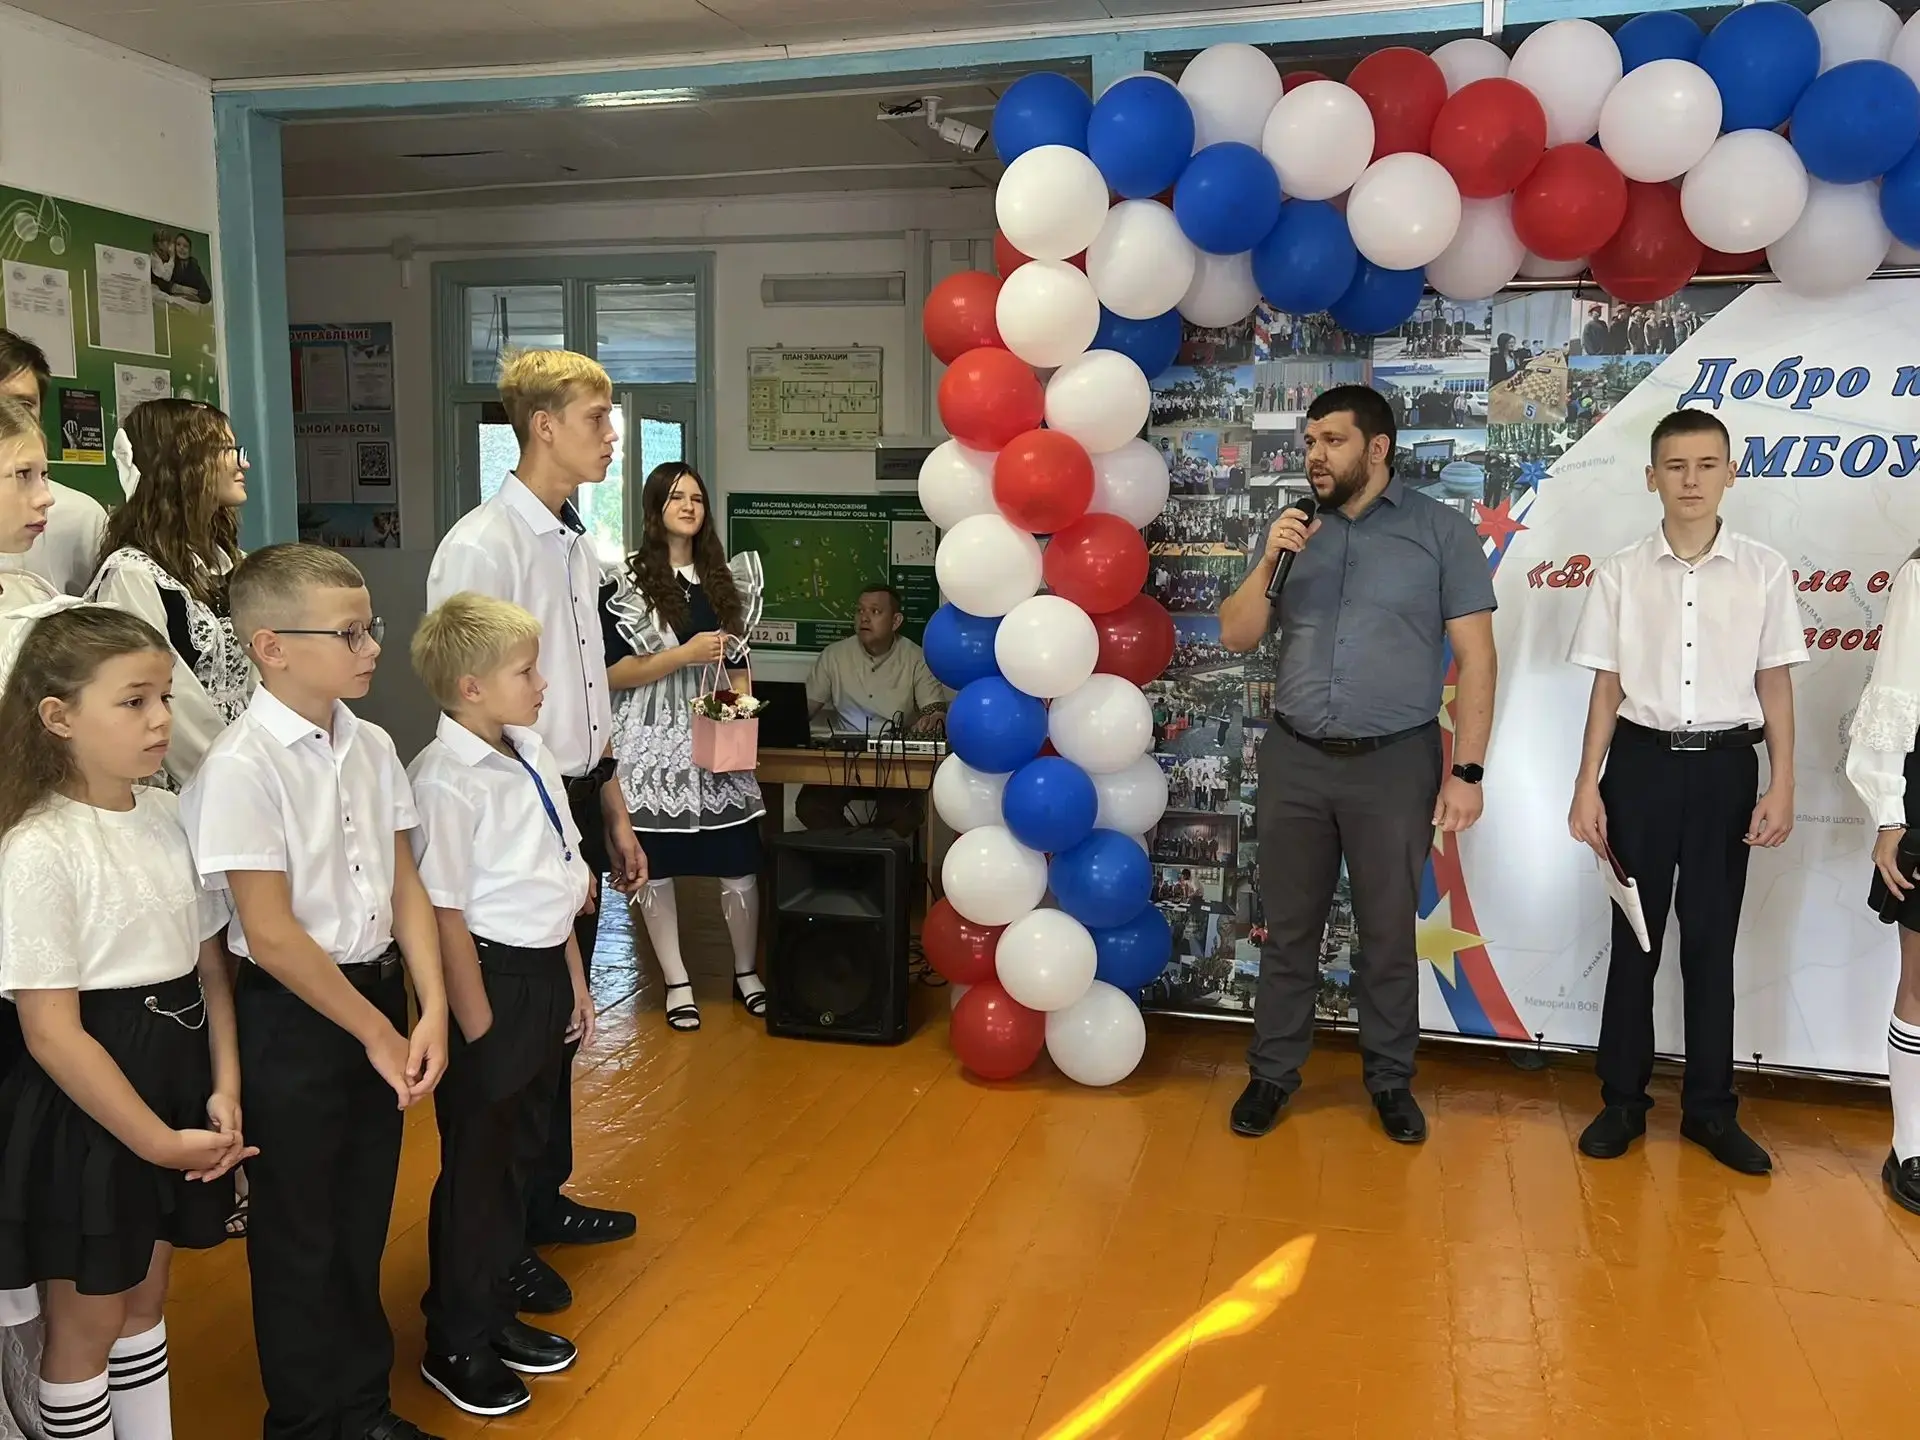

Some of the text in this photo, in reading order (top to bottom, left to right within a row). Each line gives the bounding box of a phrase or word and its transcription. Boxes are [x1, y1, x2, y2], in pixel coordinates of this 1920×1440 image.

[1676, 355, 1871, 410] Добро
[1525, 405, 1534, 417] 5
[334, 422, 380, 433] РАБОТЫ
[733, 508, 793, 516] ОБРАЗОВАТЕЛЬНОГО
[776, 631, 790, 641] 01
[1524, 996, 1599, 1012] Мемориал ВОВ
